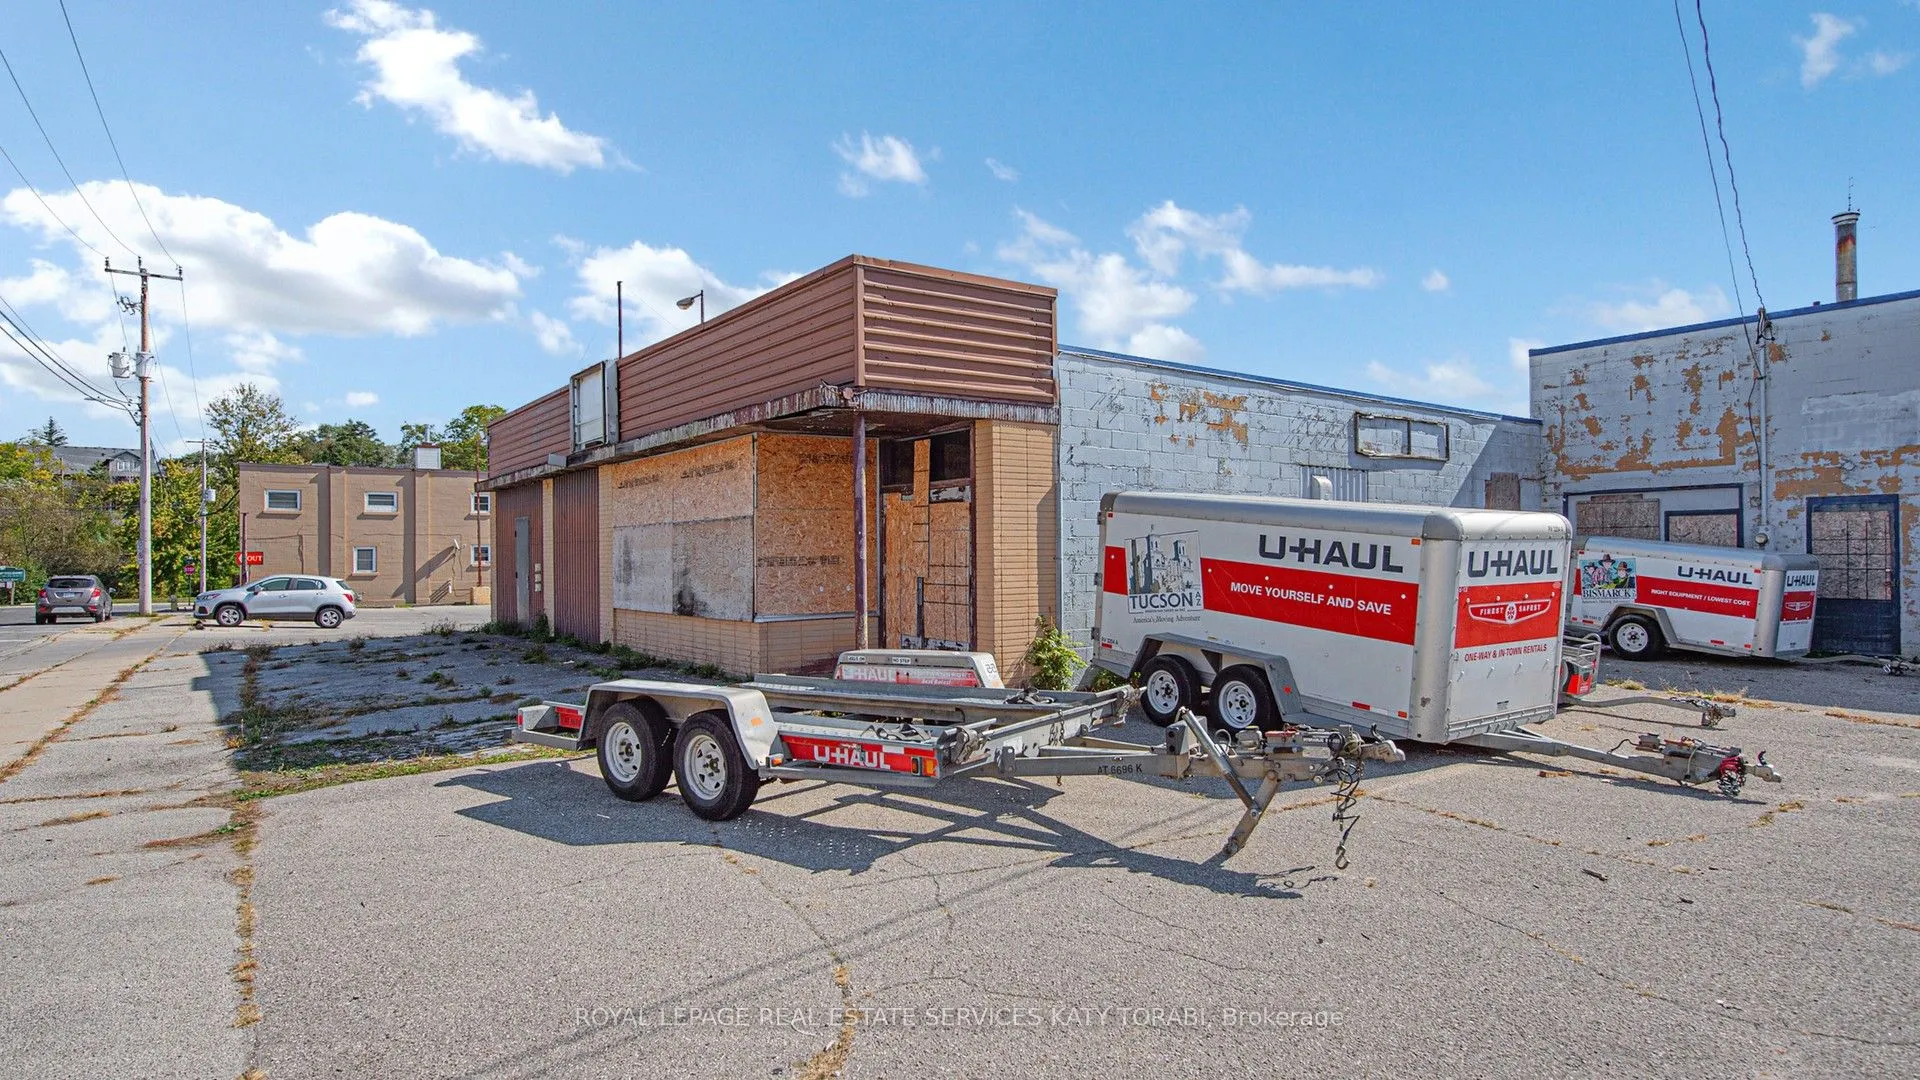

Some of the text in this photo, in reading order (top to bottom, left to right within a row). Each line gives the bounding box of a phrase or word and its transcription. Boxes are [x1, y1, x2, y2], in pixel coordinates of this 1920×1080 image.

[1259, 534, 1403, 573] U-HAUL
[1467, 549, 1558, 578] U-HAUL
[1678, 565, 1753, 585] U-HAUL
[1786, 574, 1816, 587] U-HAUL
[1129, 592, 1193, 610] TUCSON
[1230, 581, 1392, 615] MOVE YOURSELF AND SAVE
[1583, 589, 1631, 598] BISMARCK
[1668, 591, 1702, 600] EQUIPMENT
[1707, 596, 1732, 604] LOWEST
[1479, 603, 1541, 616] FINEST SAFEST
[1464, 652, 1491, 662] ONE-WAY
[1498, 647, 1523, 658] IN-TOWN
[1523, 643, 1548, 654] RENTALS
[813, 745, 891, 770] U-HAUL
[1098, 763, 1143, 775] AT 6696 K
